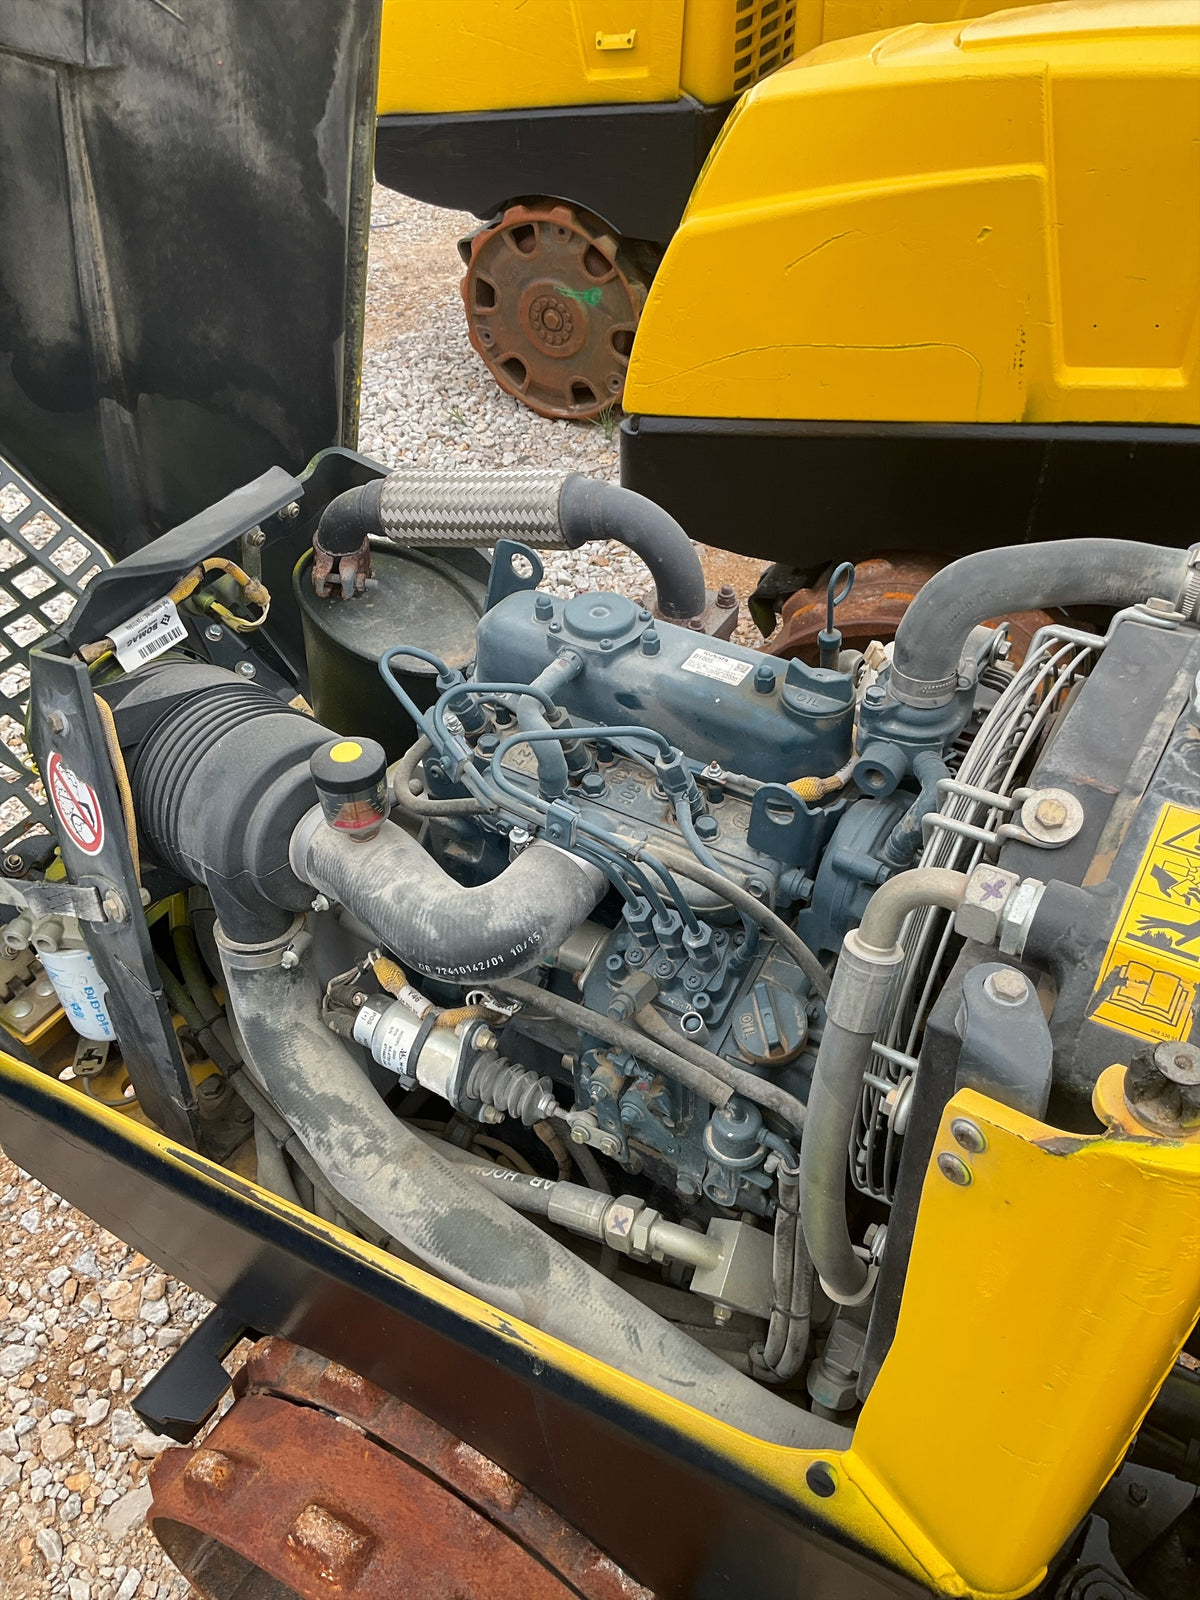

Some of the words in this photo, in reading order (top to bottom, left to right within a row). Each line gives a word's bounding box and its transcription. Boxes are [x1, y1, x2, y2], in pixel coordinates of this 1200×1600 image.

[796, 693, 819, 708] OIL
[510, 931, 541, 957] 10/15
[739, 1012, 757, 1041] OIL
